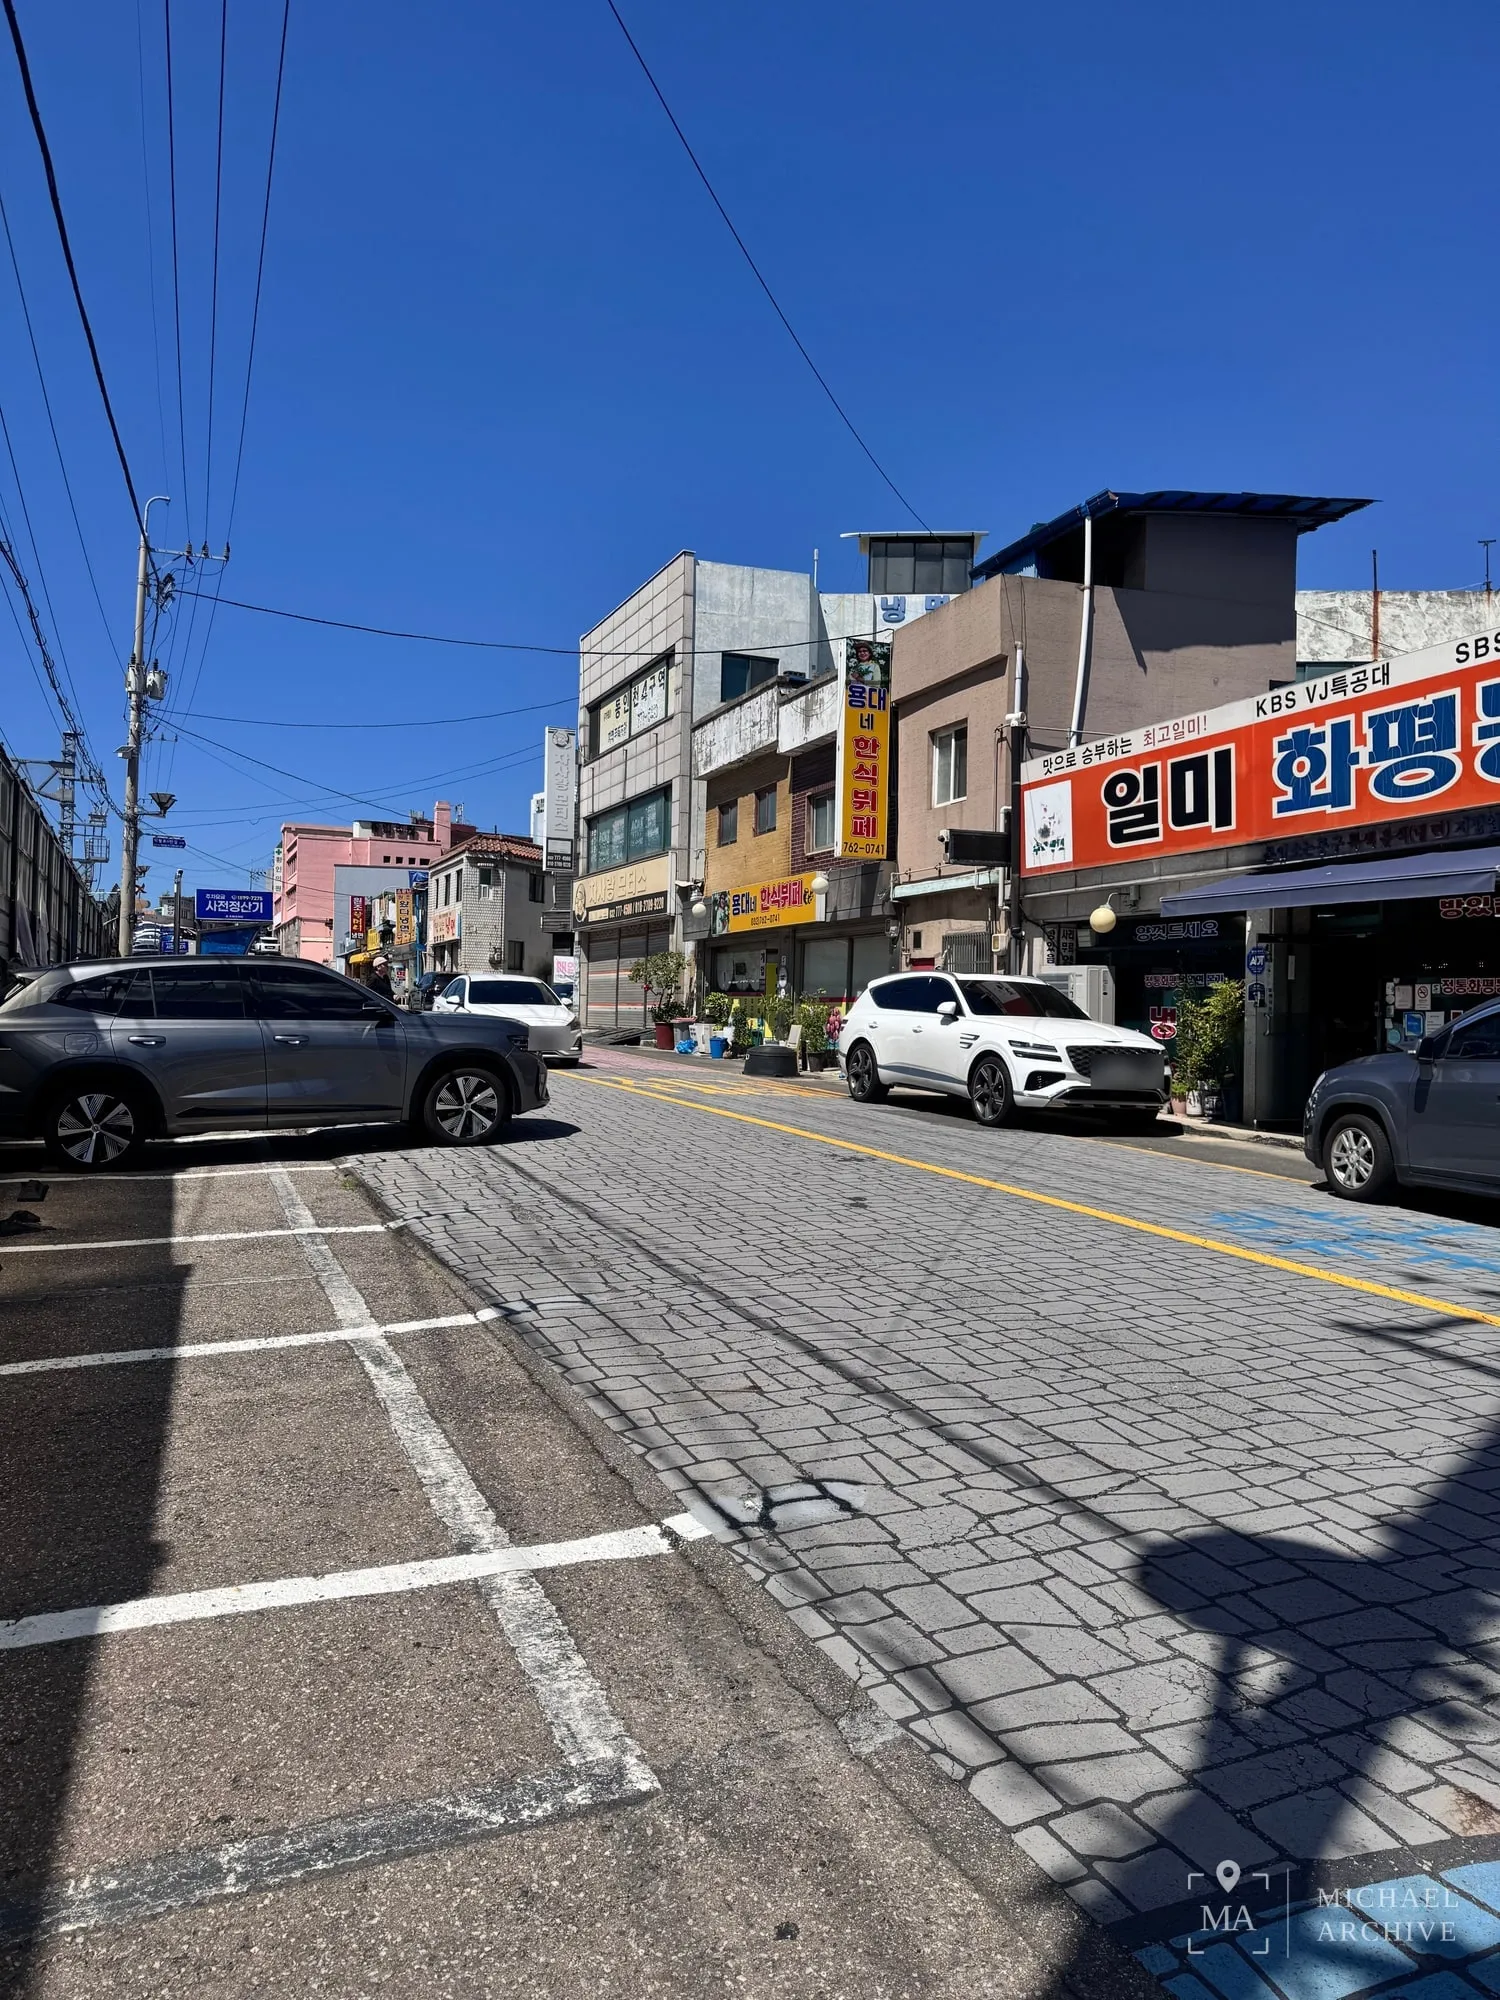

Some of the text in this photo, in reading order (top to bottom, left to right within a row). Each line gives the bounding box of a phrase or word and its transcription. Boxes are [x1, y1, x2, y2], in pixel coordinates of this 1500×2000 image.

[880, 595, 906, 624] 냉
[848, 683, 887, 712] 용대
[1256, 662, 1390, 717] KBS VJ특공대
[859, 712, 874, 731] 네
[1042, 715, 1208, 776] 맛으로 승부하는 최고일미!
[851, 735, 880, 840] 한식뷔페
[1101, 742, 1237, 849] 일미
[843, 840, 885, 855] 762-0741
[205, 900, 263, 914] 사전정산기
[732, 879, 803, 916] 용대네 한식뷔페
[1136, 920, 1219, 942] 양껏드세요
[1150, 1006, 1178, 1040] 냉
